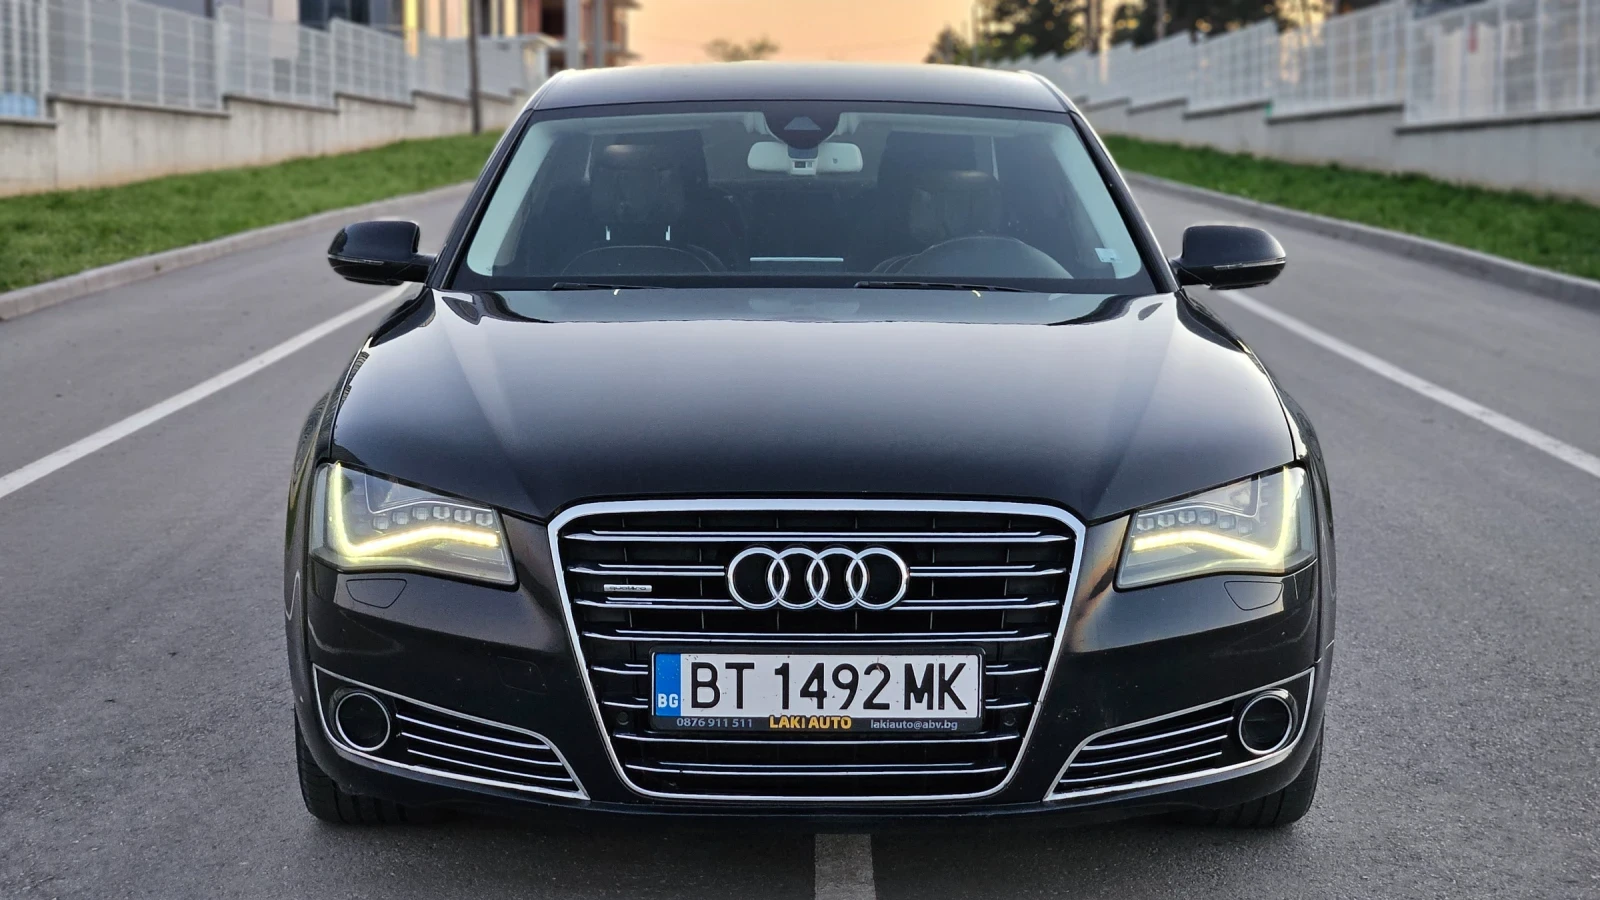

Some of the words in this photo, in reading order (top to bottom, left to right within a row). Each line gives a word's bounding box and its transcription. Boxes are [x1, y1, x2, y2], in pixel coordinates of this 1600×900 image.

[690, 662, 755, 710] BT
[774, 662, 891, 711] 1492
[903, 662, 967, 711] MK
[657, 693, 679, 708] BG
[676, 717, 706, 728] 0876
[707, 717, 729, 728] 911
[731, 718, 753, 728] 511
[769, 715, 806, 729] LAKI
[808, 716, 852, 730] AUTO
[870, 718, 958, 731] lakiauto@abv.bg
